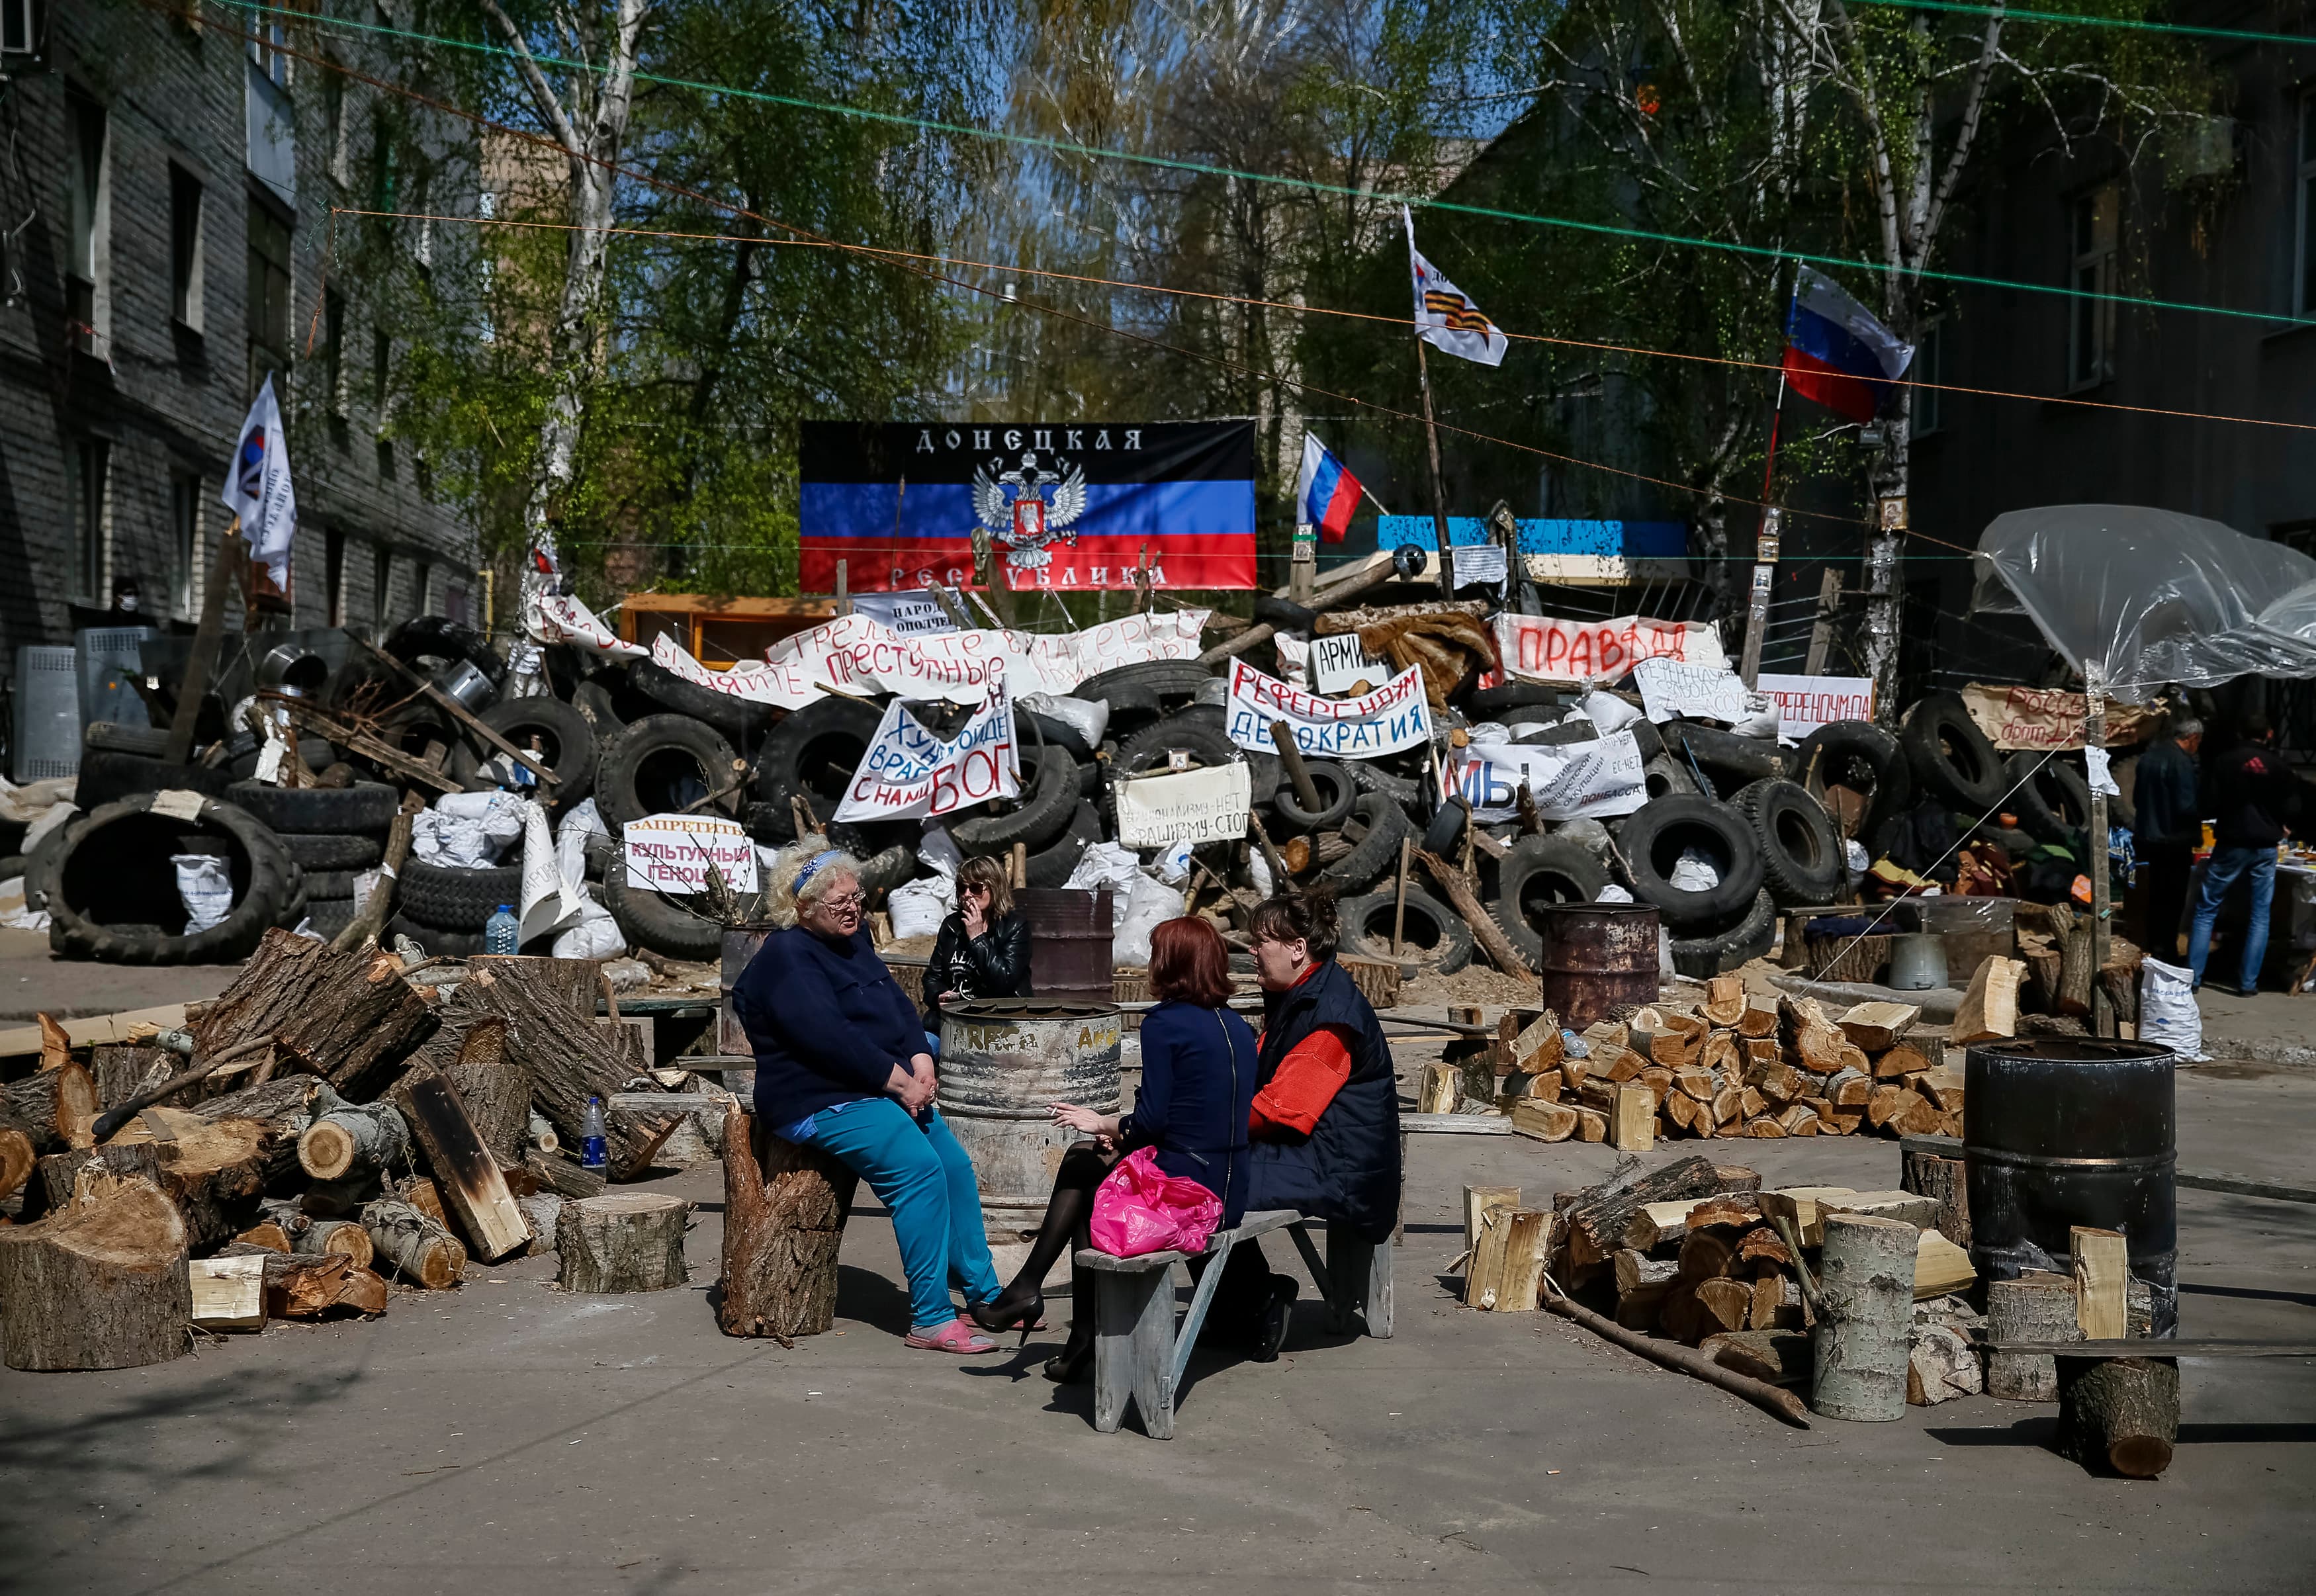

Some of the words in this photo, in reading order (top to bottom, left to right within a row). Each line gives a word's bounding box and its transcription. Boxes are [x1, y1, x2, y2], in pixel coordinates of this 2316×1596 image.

[916, 429, 1143, 454] ДОНЕЦКАЯ
[891, 566, 1167, 589] РЕСУБЛИКА
[893, 601, 943, 619] НАРОД
[1233, 662, 1418, 720] РЕФЕРЕНДУМ
[1231, 704, 1423, 752] ДЕОКРАТИЯ
[930, 743, 1010, 816] БОГ
[1563, 756, 1605, 807] оккупации
[629, 819, 742, 836] ЗАПРЕТИТЬ
[632, 842, 751, 862] КУЛЬТУРНЫЙ
[648, 864, 736, 885] ГЕНОЦД
